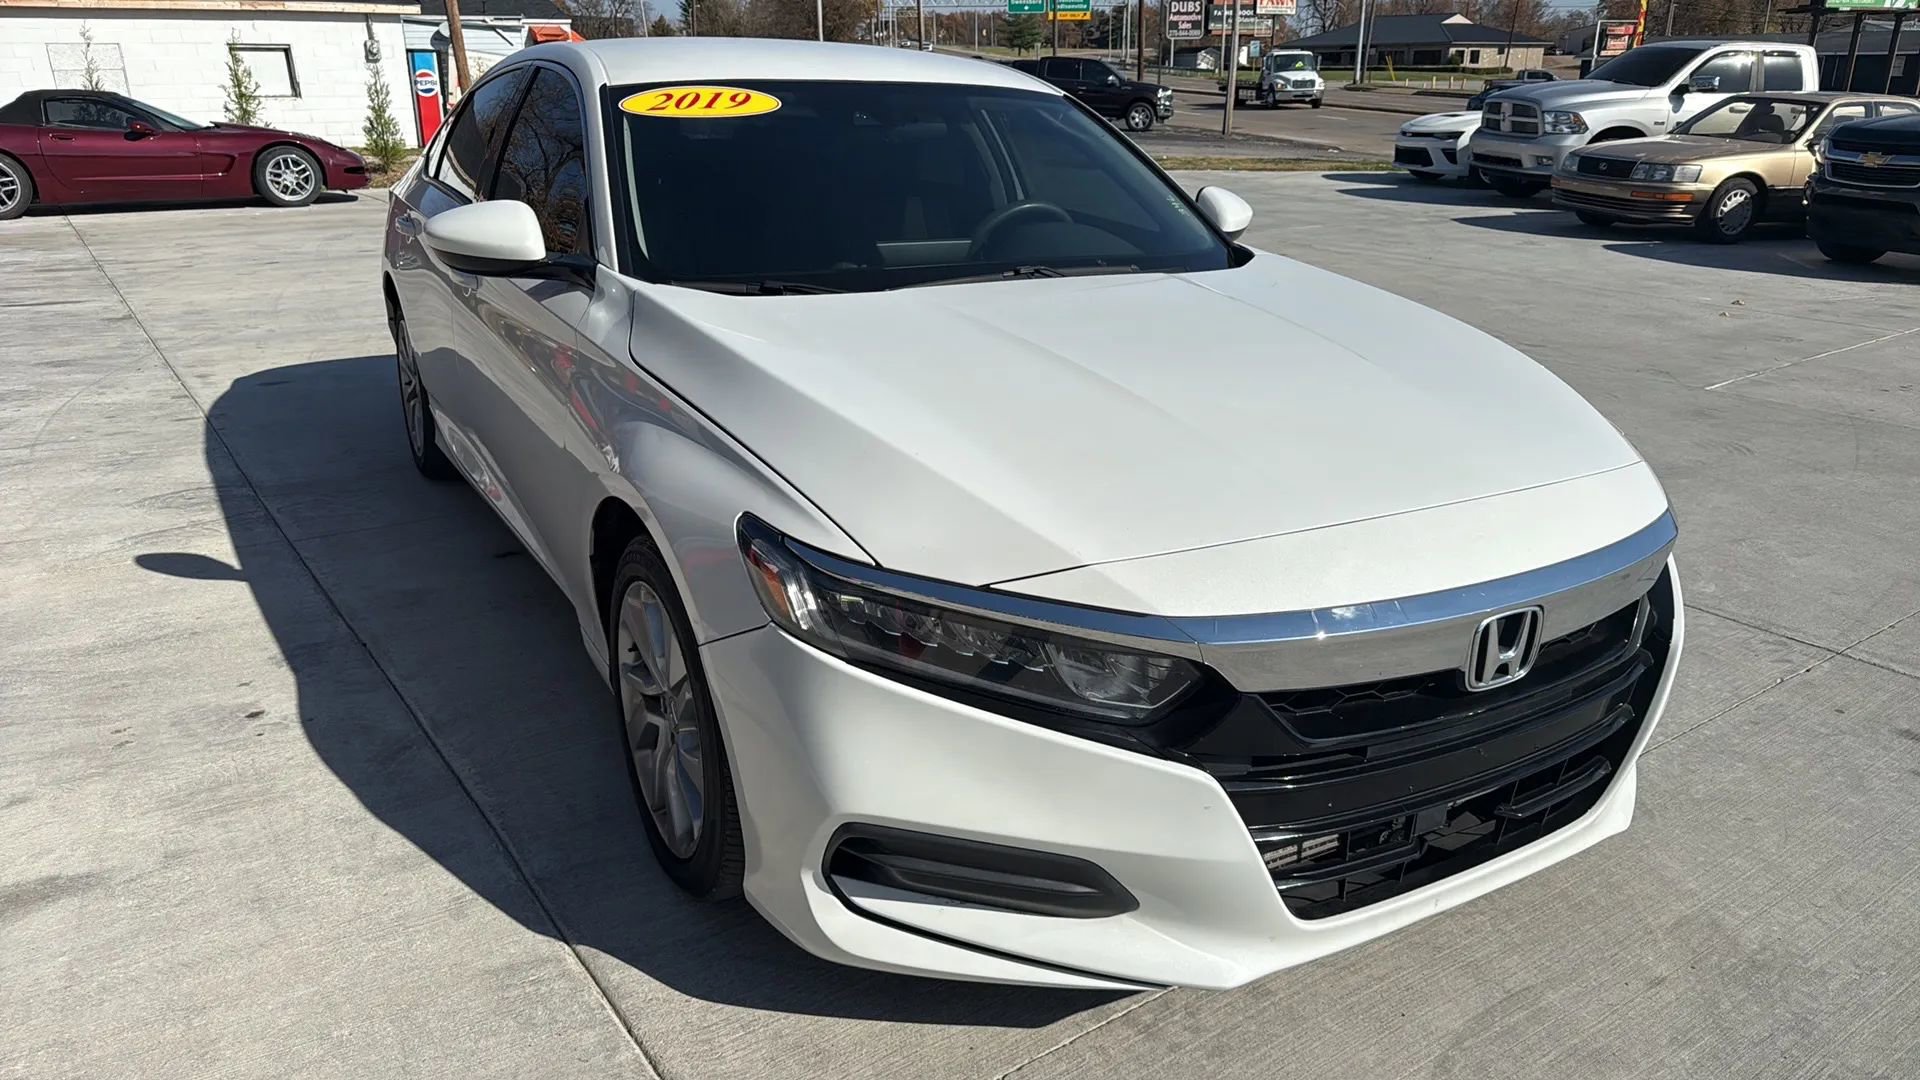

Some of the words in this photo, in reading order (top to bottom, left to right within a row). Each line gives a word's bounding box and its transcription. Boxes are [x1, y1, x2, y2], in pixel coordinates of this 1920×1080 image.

[1171, 1, 1201, 13] DUBS
[1168, 13, 1201, 22] Automotive
[1178, 21, 1192, 30] Sales
[647, 91, 752, 111] 2019
